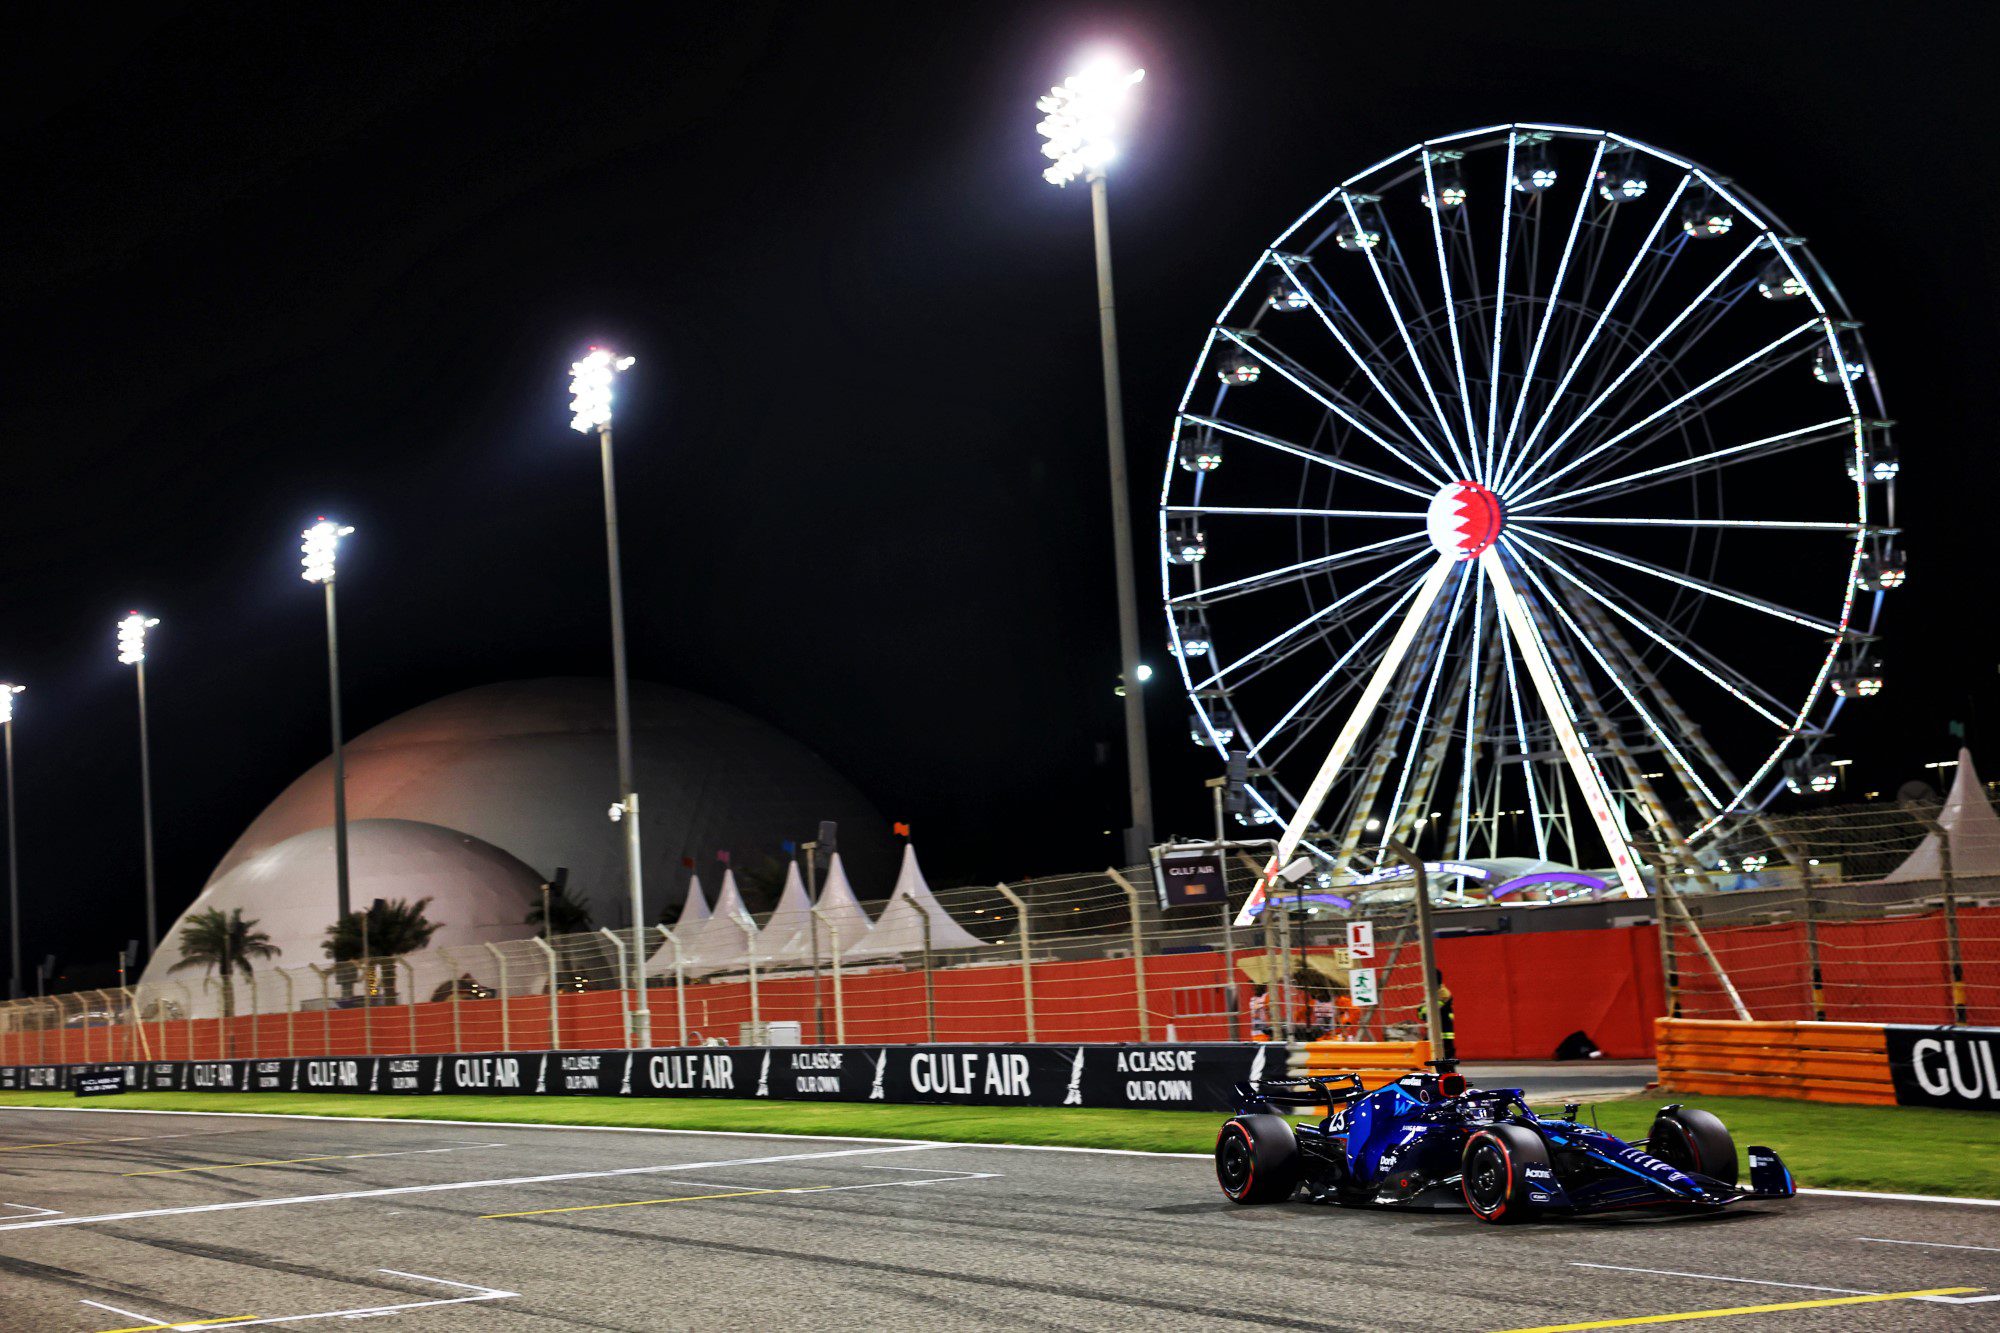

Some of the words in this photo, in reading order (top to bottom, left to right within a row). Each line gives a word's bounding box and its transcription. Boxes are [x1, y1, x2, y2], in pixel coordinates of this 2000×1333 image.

[650, 1055, 698, 1089] GULF
[701, 1054, 734, 1090] AIR
[791, 1053, 800, 1069] A
[799, 1053, 829, 1070] CLASS
[1116, 1051, 1129, 1072] A
[1128, 1051, 1176, 1072] CLASS
[1176, 1050, 1196, 1071] OF
[454, 1058, 492, 1088] GULF
[494, 1057, 520, 1088] AIR
[910, 1052, 978, 1095] GULF
[984, 1052, 1031, 1097] AIR
[796, 1076, 818, 1092] OUR
[817, 1076, 840, 1092] OWN
[1126, 1080, 1157, 1101] OUR
[1157, 1080, 1193, 1101] OWN
[1328, 1110, 1345, 1132] 23
